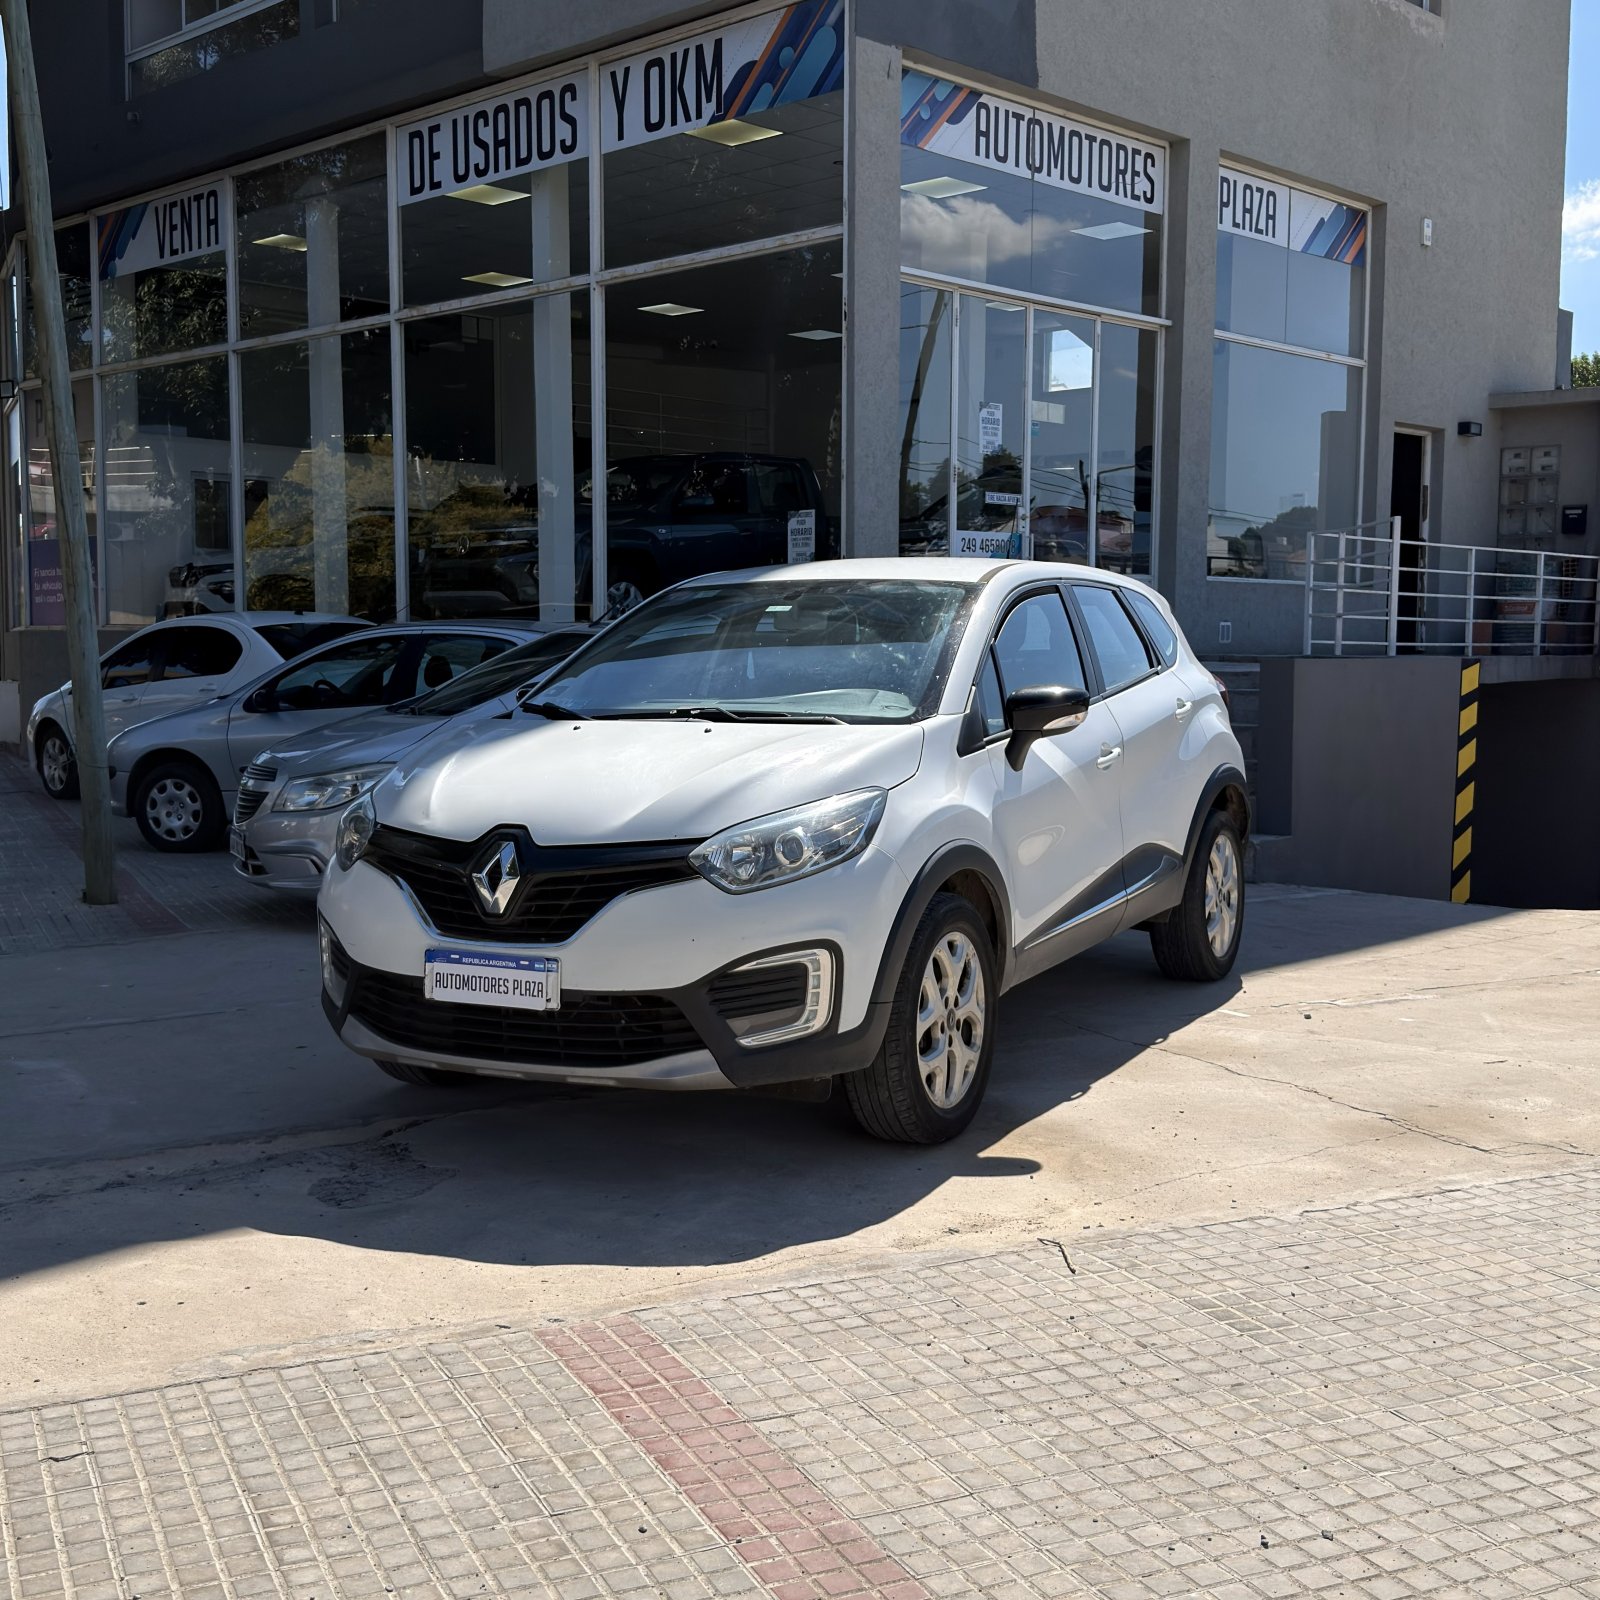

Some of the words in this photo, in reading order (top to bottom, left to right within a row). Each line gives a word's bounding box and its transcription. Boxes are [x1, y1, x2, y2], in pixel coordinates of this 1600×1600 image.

[155, 190, 219, 259] VENTA
[408, 123, 442, 196] DE
[452, 83, 578, 184] USADOS
[610, 66, 631, 141] Y
[975, 102, 1156, 205] AUTOMOTORES
[1219, 175, 1277, 238] PLAZA
[790, 527, 813, 537] HORARIO
[961, 537, 977, 553] 249
[462, 957, 490, 966] REPUBLICA
[489, 959, 517, 968] ARGENTINA
[435, 972, 509, 995] AUTOMOTORES
[512, 979, 544, 999] PLAZA
